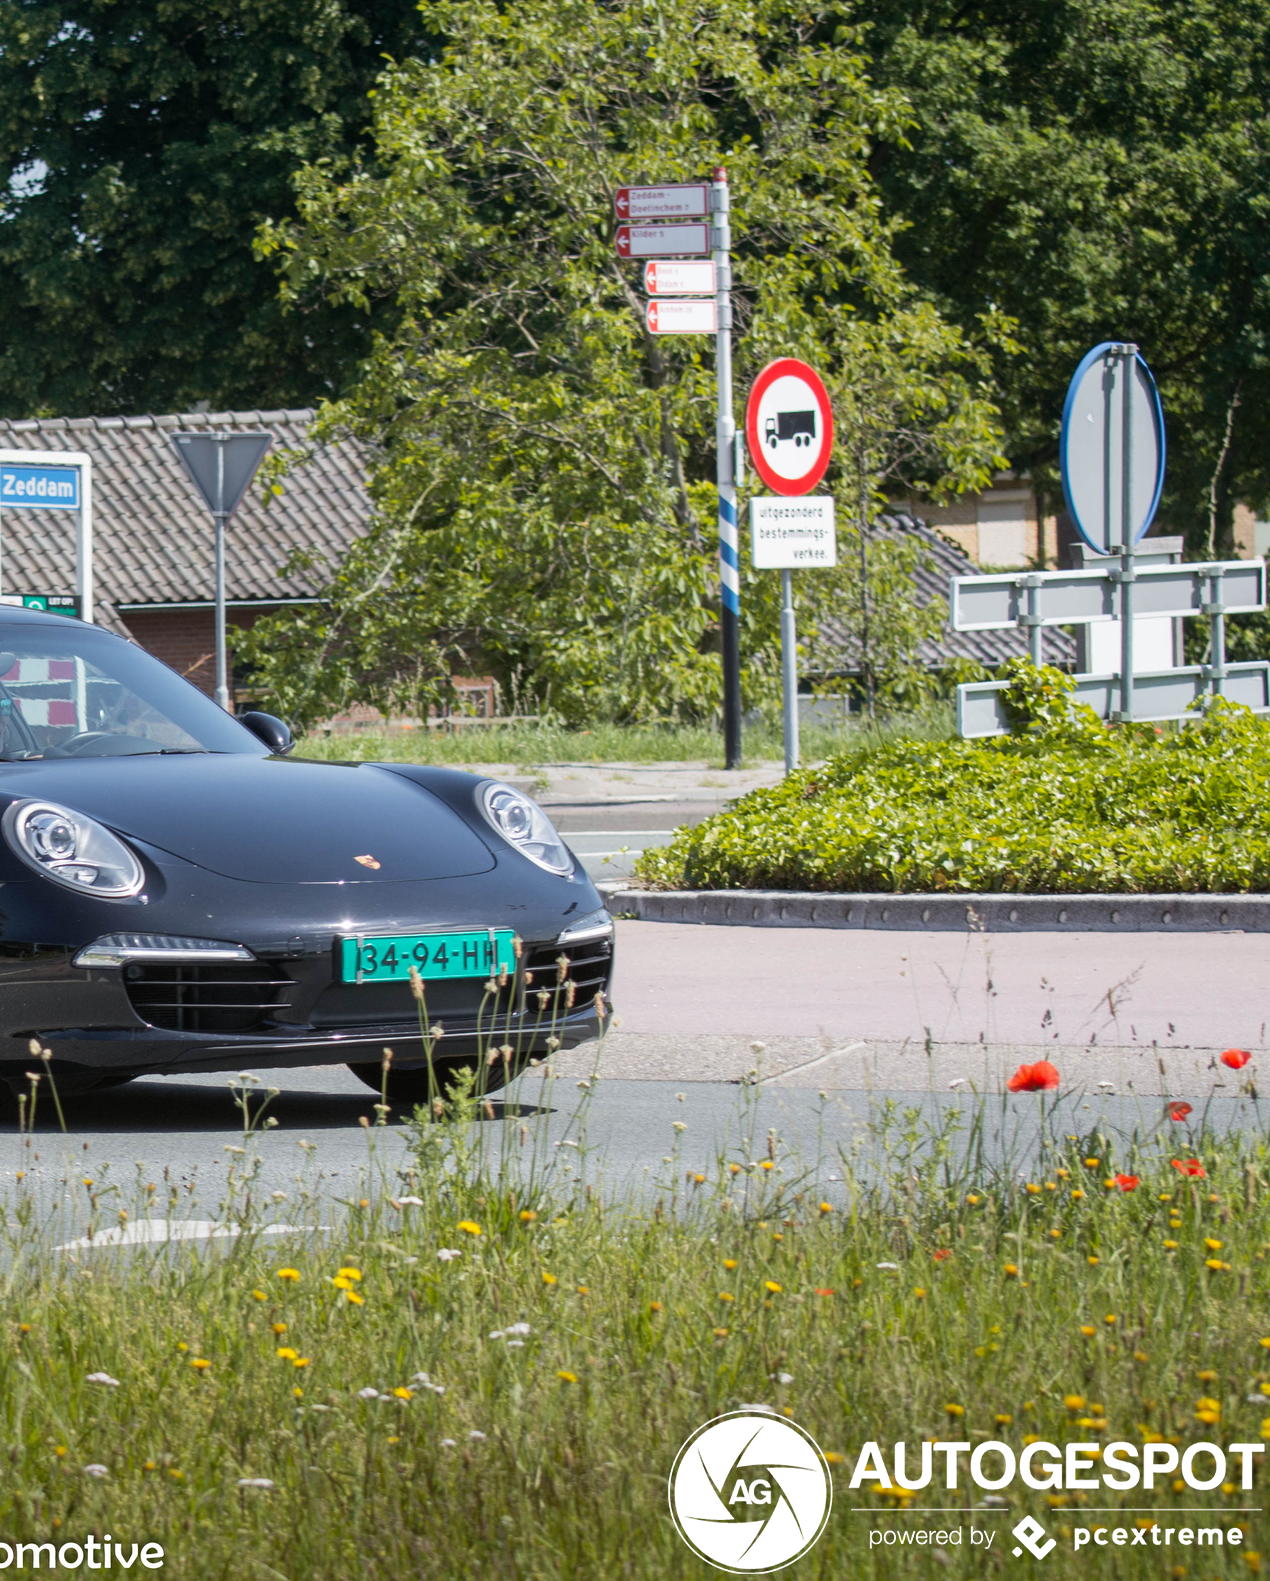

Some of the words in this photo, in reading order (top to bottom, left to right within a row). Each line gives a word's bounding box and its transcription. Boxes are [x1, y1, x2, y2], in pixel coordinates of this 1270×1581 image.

[631, 191, 664, 200] Zeddam
[631, 203, 682, 213] Doetinchem
[631, 230, 657, 238] Kilder
[2, 474, 74, 498] Zeddam
[759, 505, 823, 521] uitgezonderd
[759, 527, 829, 542] bestemmings-
